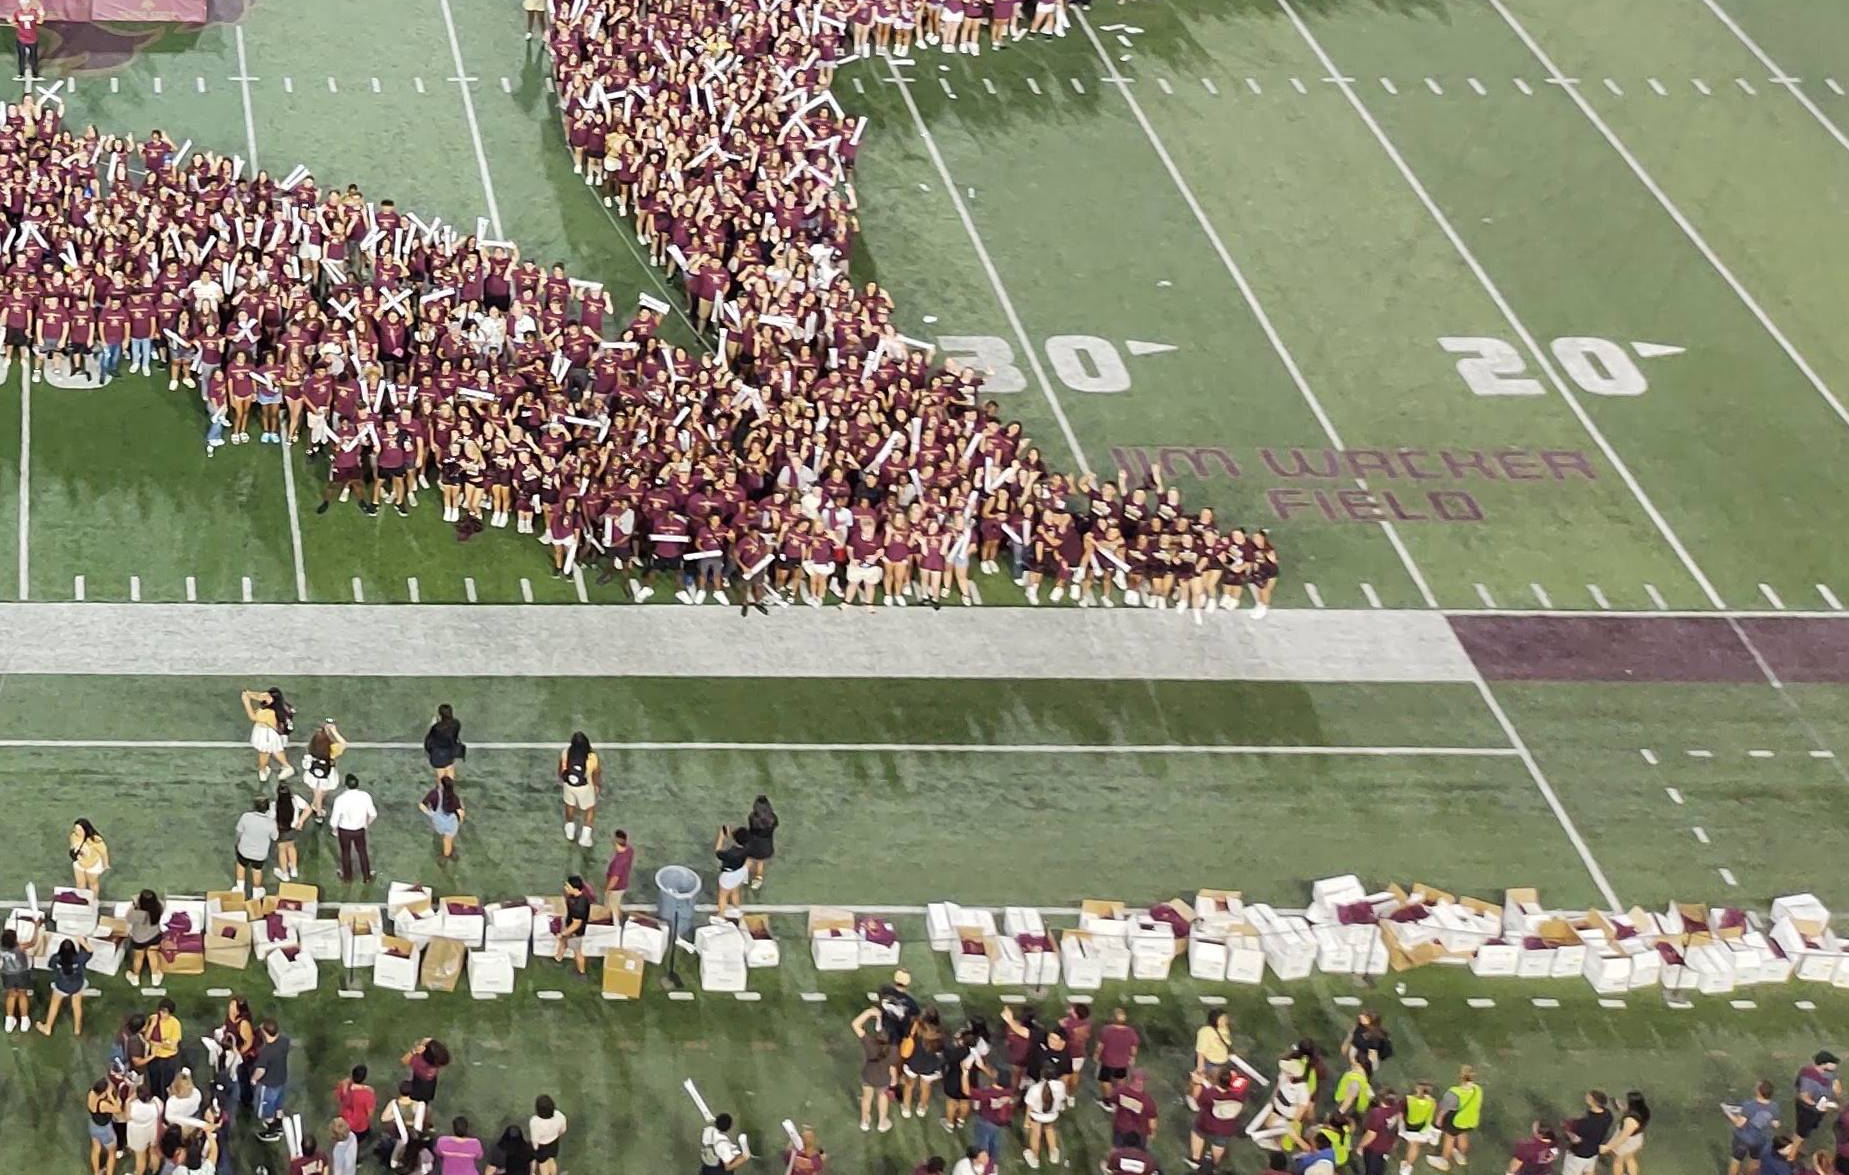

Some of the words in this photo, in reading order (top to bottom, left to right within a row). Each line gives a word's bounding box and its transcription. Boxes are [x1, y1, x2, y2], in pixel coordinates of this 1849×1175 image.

[936, 335, 1133, 393] 30
[1436, 336, 1650, 396] 20
[1260, 448, 1597, 481] WACKER
[1266, 488, 1486, 522] FIELD
